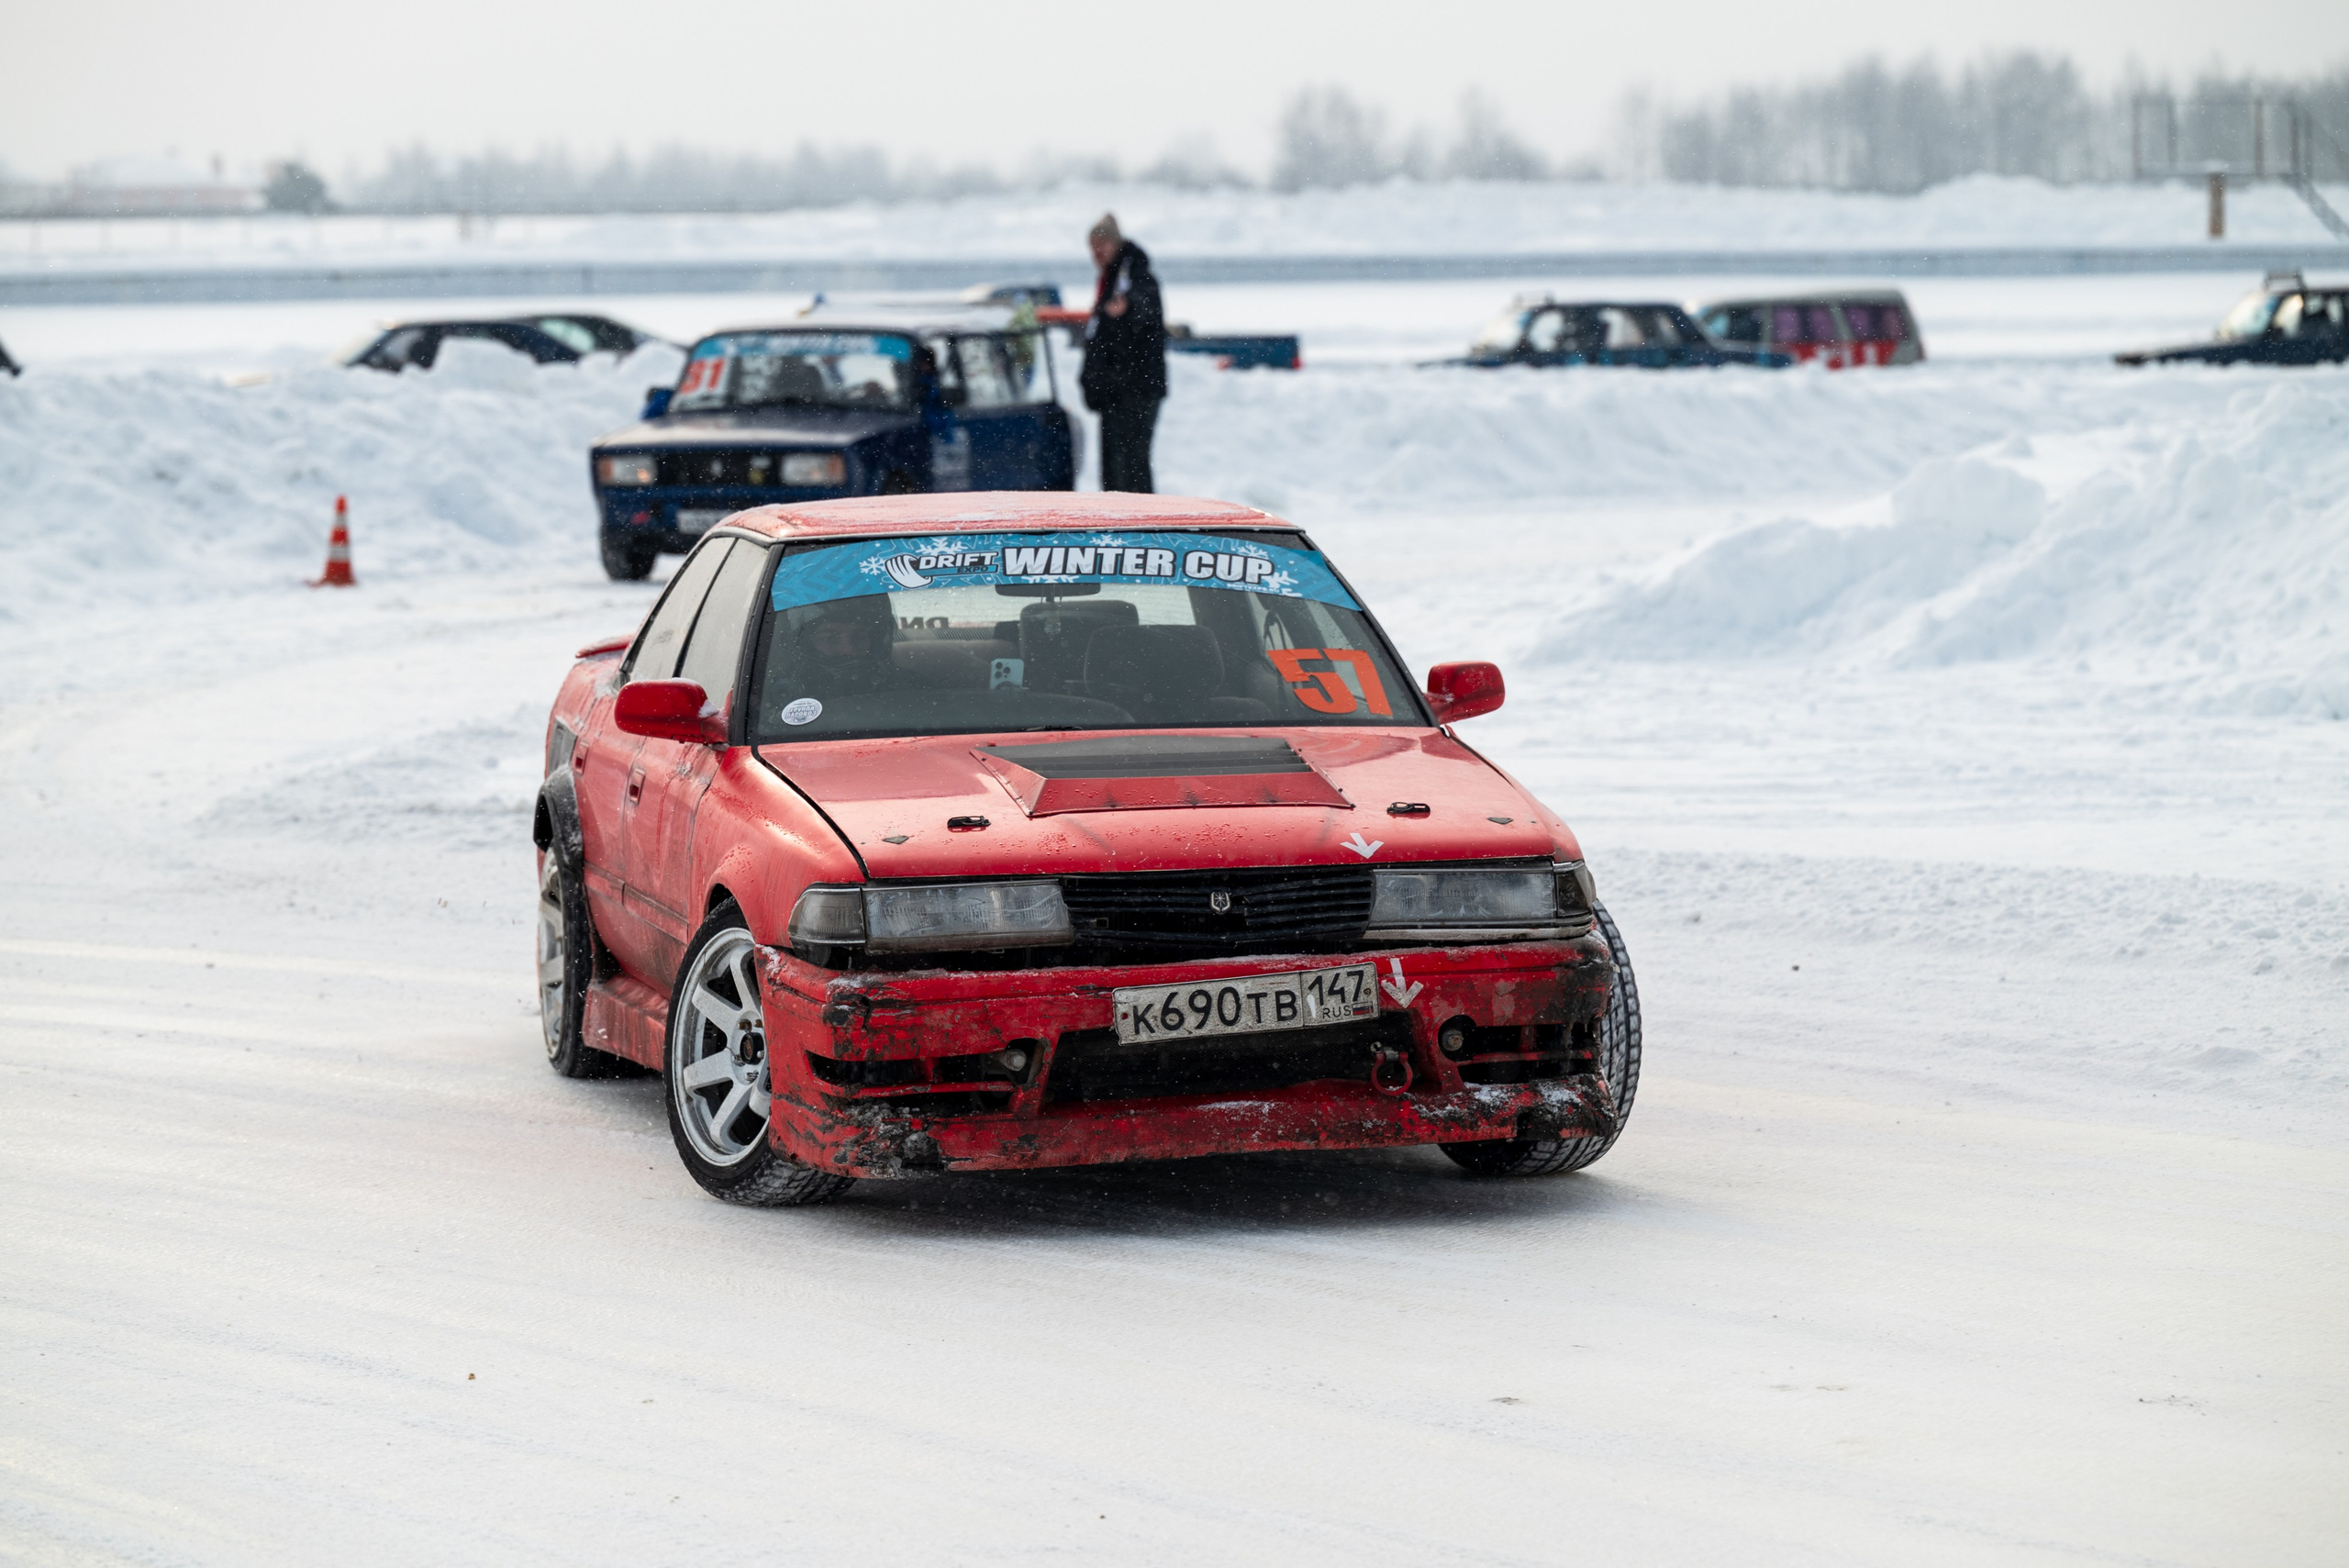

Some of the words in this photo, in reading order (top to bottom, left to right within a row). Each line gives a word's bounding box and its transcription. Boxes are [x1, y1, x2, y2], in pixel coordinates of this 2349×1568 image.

[918, 552, 998, 570] DRIFT
[1004, 547, 1175, 576] WINTER
[1184, 550, 1274, 584] CUP
[1266, 649, 1393, 717] 57
[1308, 970, 1364, 1006] 147
[1322, 1004, 1352, 1019] RUS
